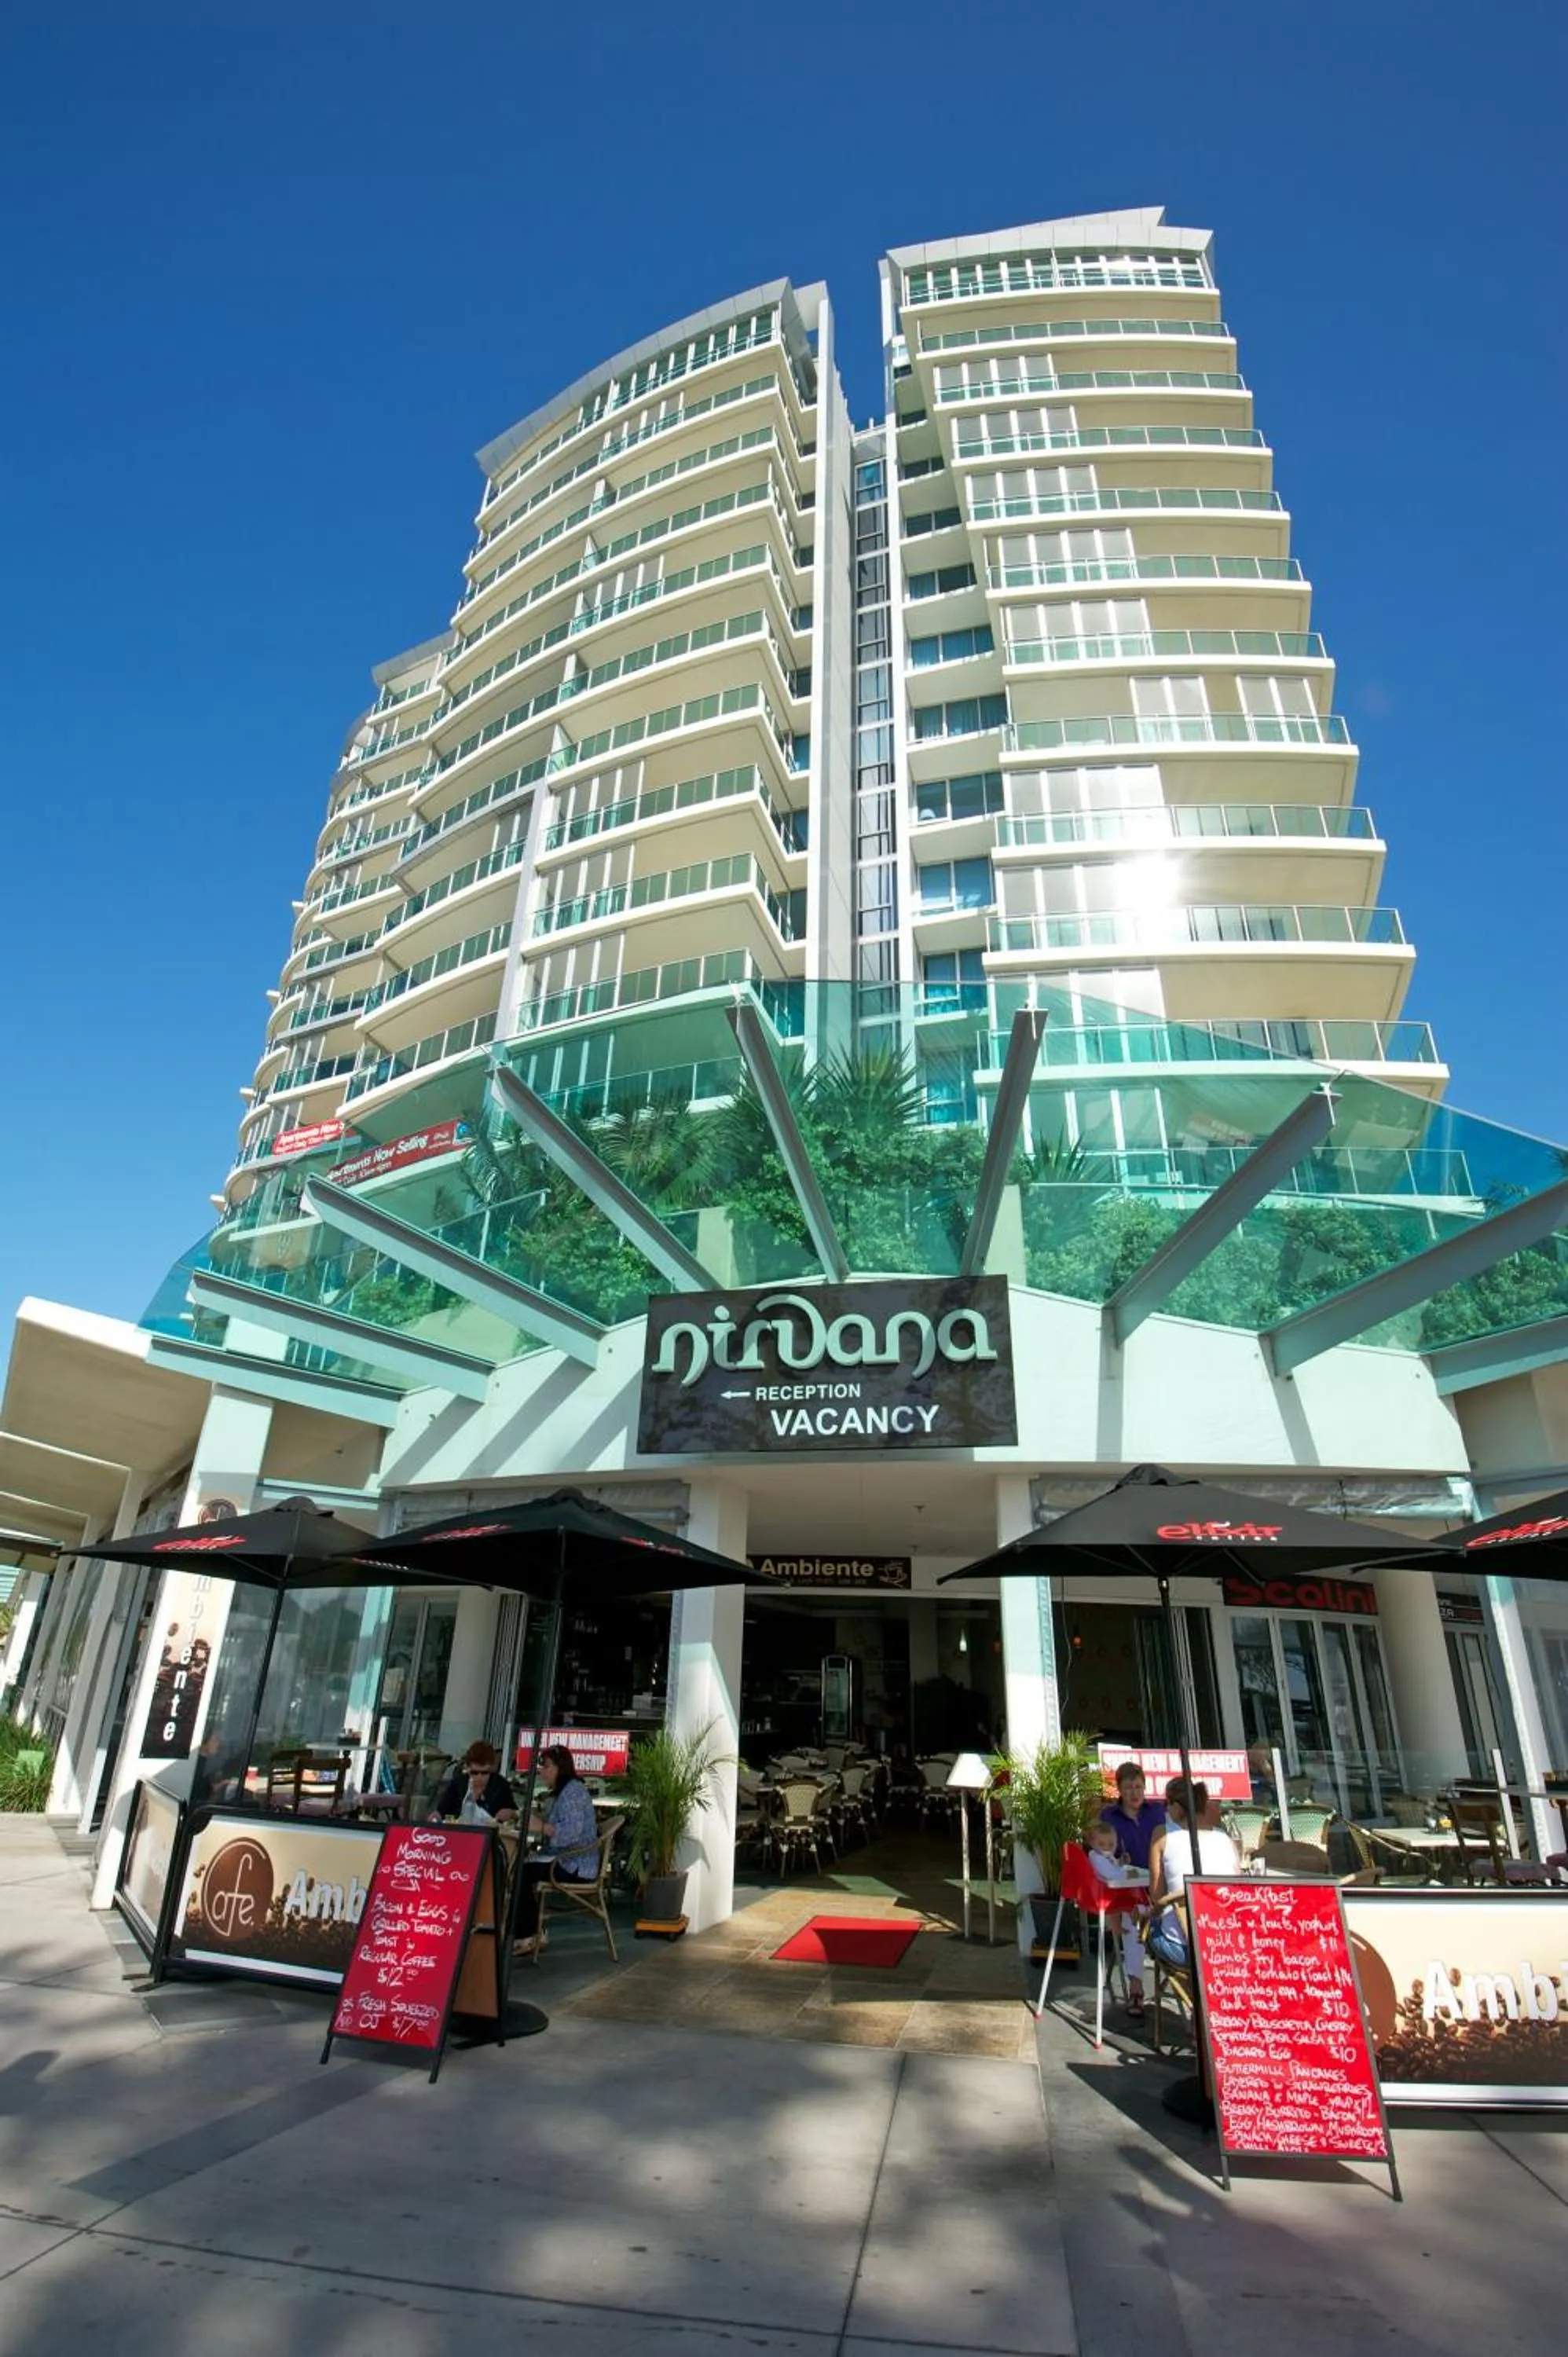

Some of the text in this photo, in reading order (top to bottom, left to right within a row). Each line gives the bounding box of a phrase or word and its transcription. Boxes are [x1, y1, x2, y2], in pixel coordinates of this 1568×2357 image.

[755, 1383, 862, 1402] RECEPTION
[771, 1405, 941, 1436] VACANCY
[760, 1558, 874, 1577] Ambiente
[163, 1574, 212, 1742] mbiente
[568, 1733, 628, 1752] MANAGEMENT
[412, 1827, 446, 1846] GOOD
[397, 1842, 452, 1864] MORNING
[1216, 1886, 1298, 1911] Breakfast
[417, 1900, 448, 1921] EGGS
[401, 1952, 437, 1968] COFFEE
[1329, 2046, 1357, 2063] $10
